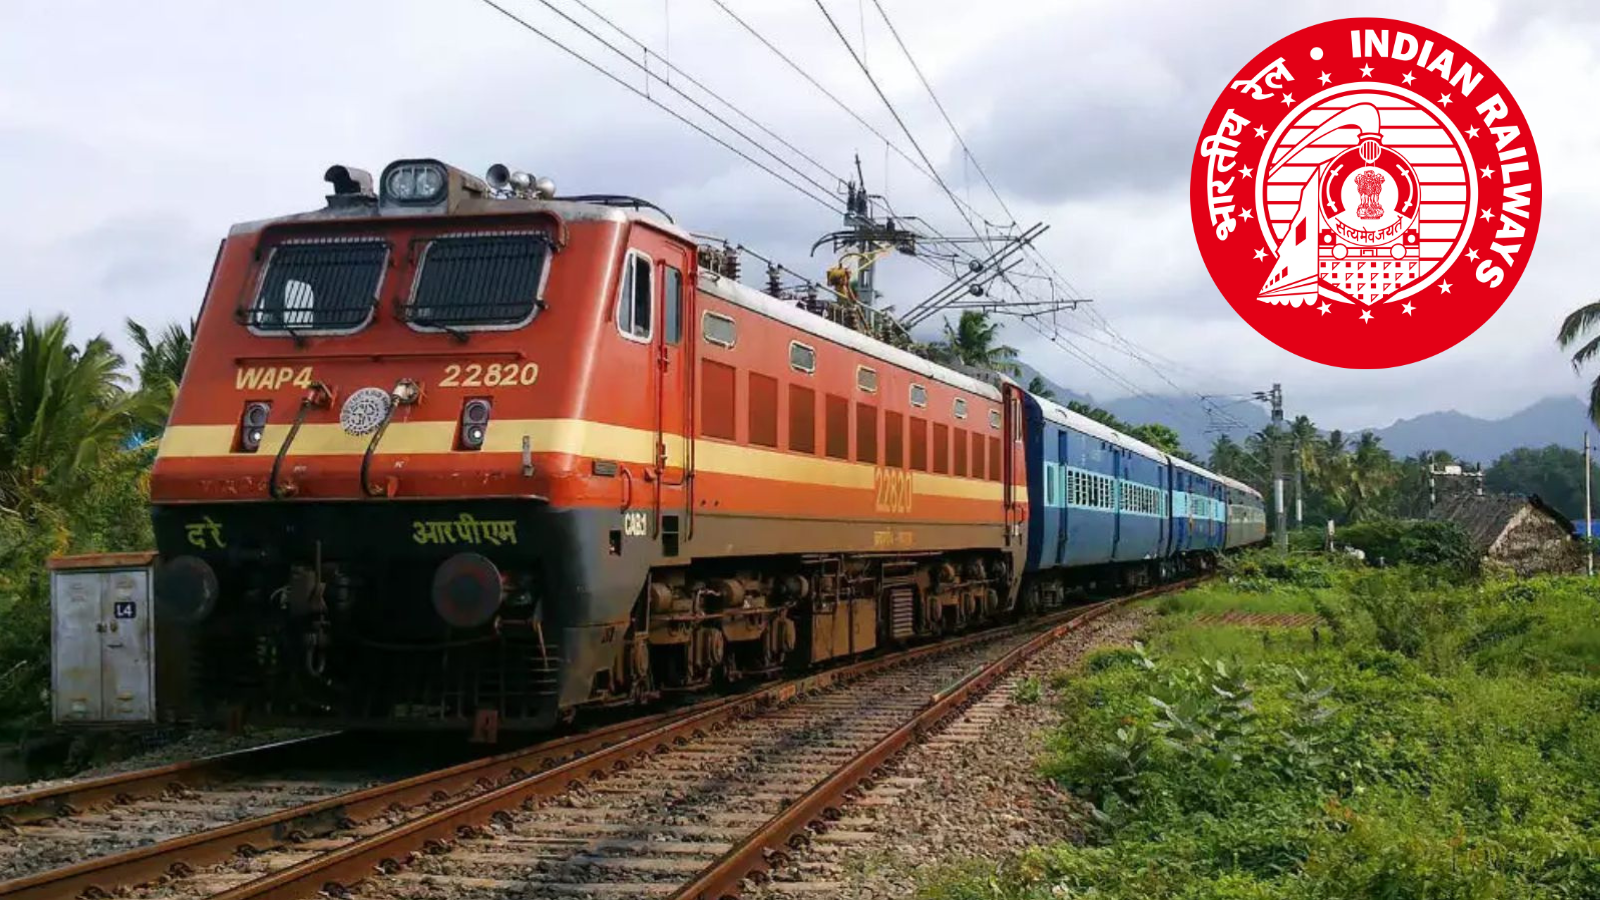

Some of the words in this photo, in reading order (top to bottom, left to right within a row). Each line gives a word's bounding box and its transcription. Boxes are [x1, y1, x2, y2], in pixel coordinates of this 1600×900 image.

[235, 366, 313, 390] WAP4
[438, 361, 539, 387] 22820
[875, 466, 913, 514] 22820
[116, 604, 132, 617] L4
